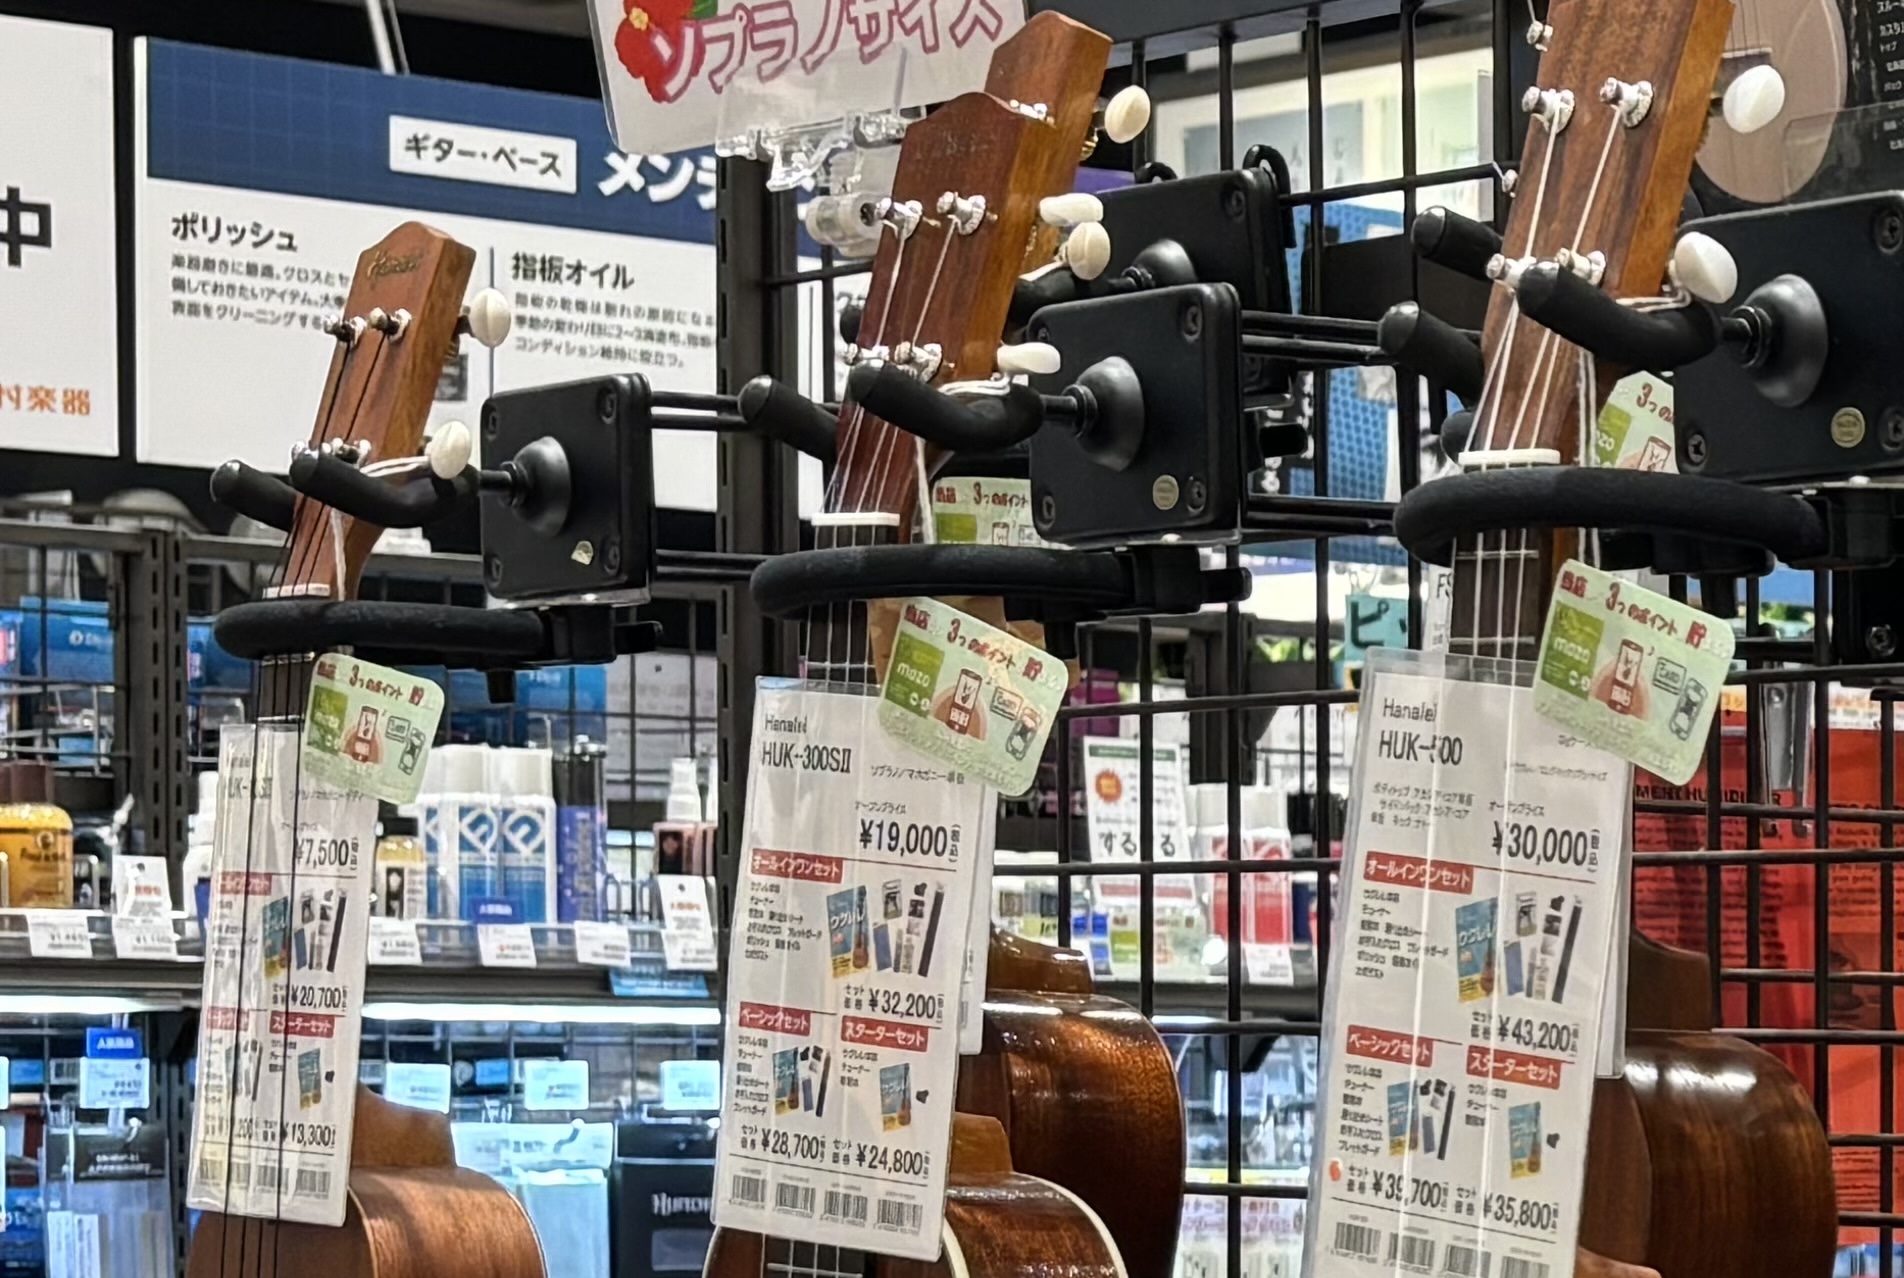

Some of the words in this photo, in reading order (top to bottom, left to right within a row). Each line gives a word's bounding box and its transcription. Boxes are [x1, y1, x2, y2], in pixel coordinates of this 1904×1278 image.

[405, 134, 562, 178] ギター・ベース
[172, 213, 297, 252] ポリッシュ
[511, 252, 635, 289] 指板オイル
[1383, 697, 1438, 722] Hanalei
[859, 819, 948, 858] ¥19,000
[1493, 821, 1588, 867] ¥30,000
[752, 852, 841, 881] オールインワンセット
[1366, 858, 1471, 887] オールインワンセット
[291, 985, 341, 1009] ¥20,700
[868, 988, 937, 1021] ¥32,200
[740, 1005, 809, 1034] ベーシックセット
[843, 1021, 927, 1048] スターターセット
[1498, 1015, 1570, 1052] ¥43,200
[1469, 1052, 1558, 1083] スターターセット
[761, 1127, 820, 1162] ¥28,700
[856, 1143, 923, 1176] ¥24,800
[1482, 1193, 1550, 1231] ¥35,800
